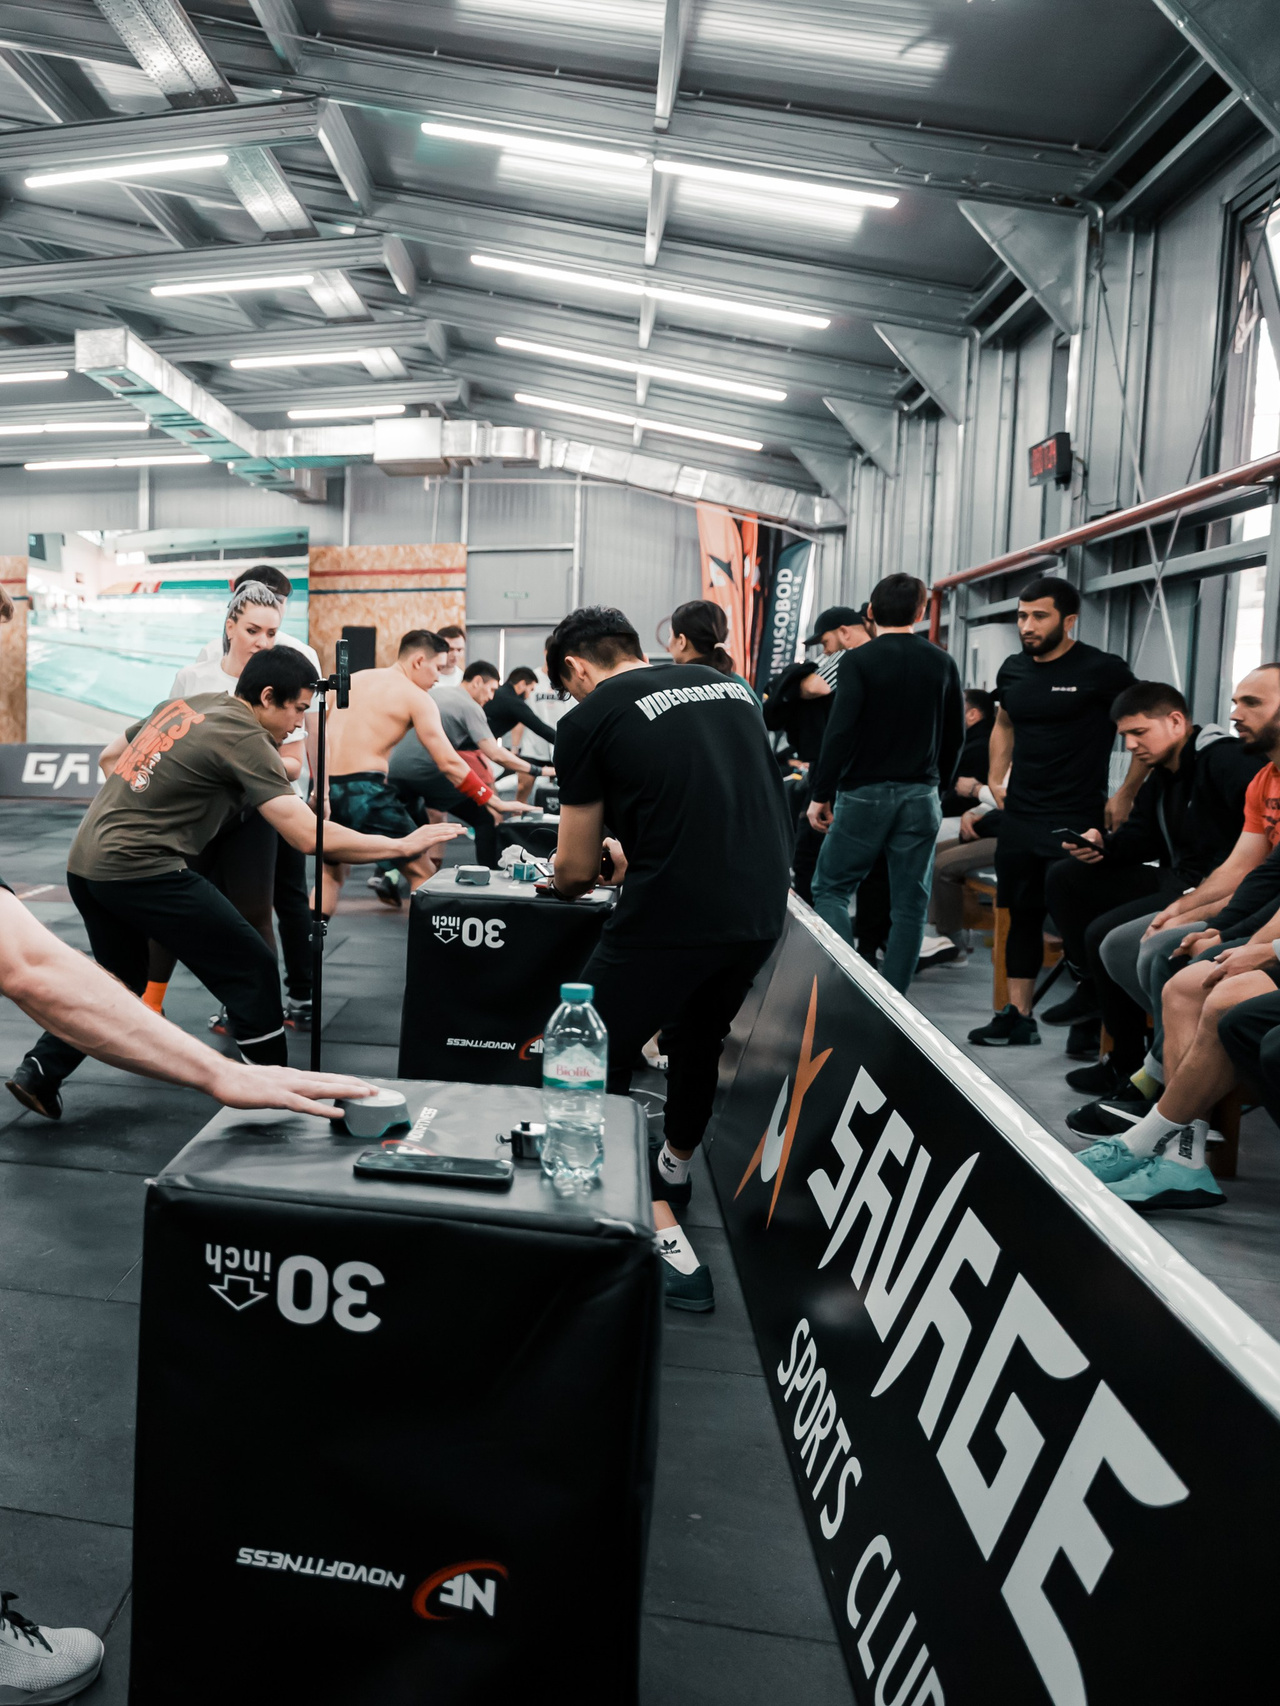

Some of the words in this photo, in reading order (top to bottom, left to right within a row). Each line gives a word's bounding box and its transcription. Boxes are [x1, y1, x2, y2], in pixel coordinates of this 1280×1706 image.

[635, 682, 754, 721] VIDEOGRAPHER
[431, 915, 461, 930] inch
[462, 917, 507, 949] 30
[446, 1037, 516, 1051] NOVOFITNESS
[205, 1243, 271, 1282] inch
[277, 1255, 385, 1333] 30
[807, 1065, 1190, 1706] SAVAGE
[778, 1318, 862, 1539] SPORTS
[236, 1547, 405, 1590] NOVOFITNESS
[439, 1573, 496, 1617] NF
